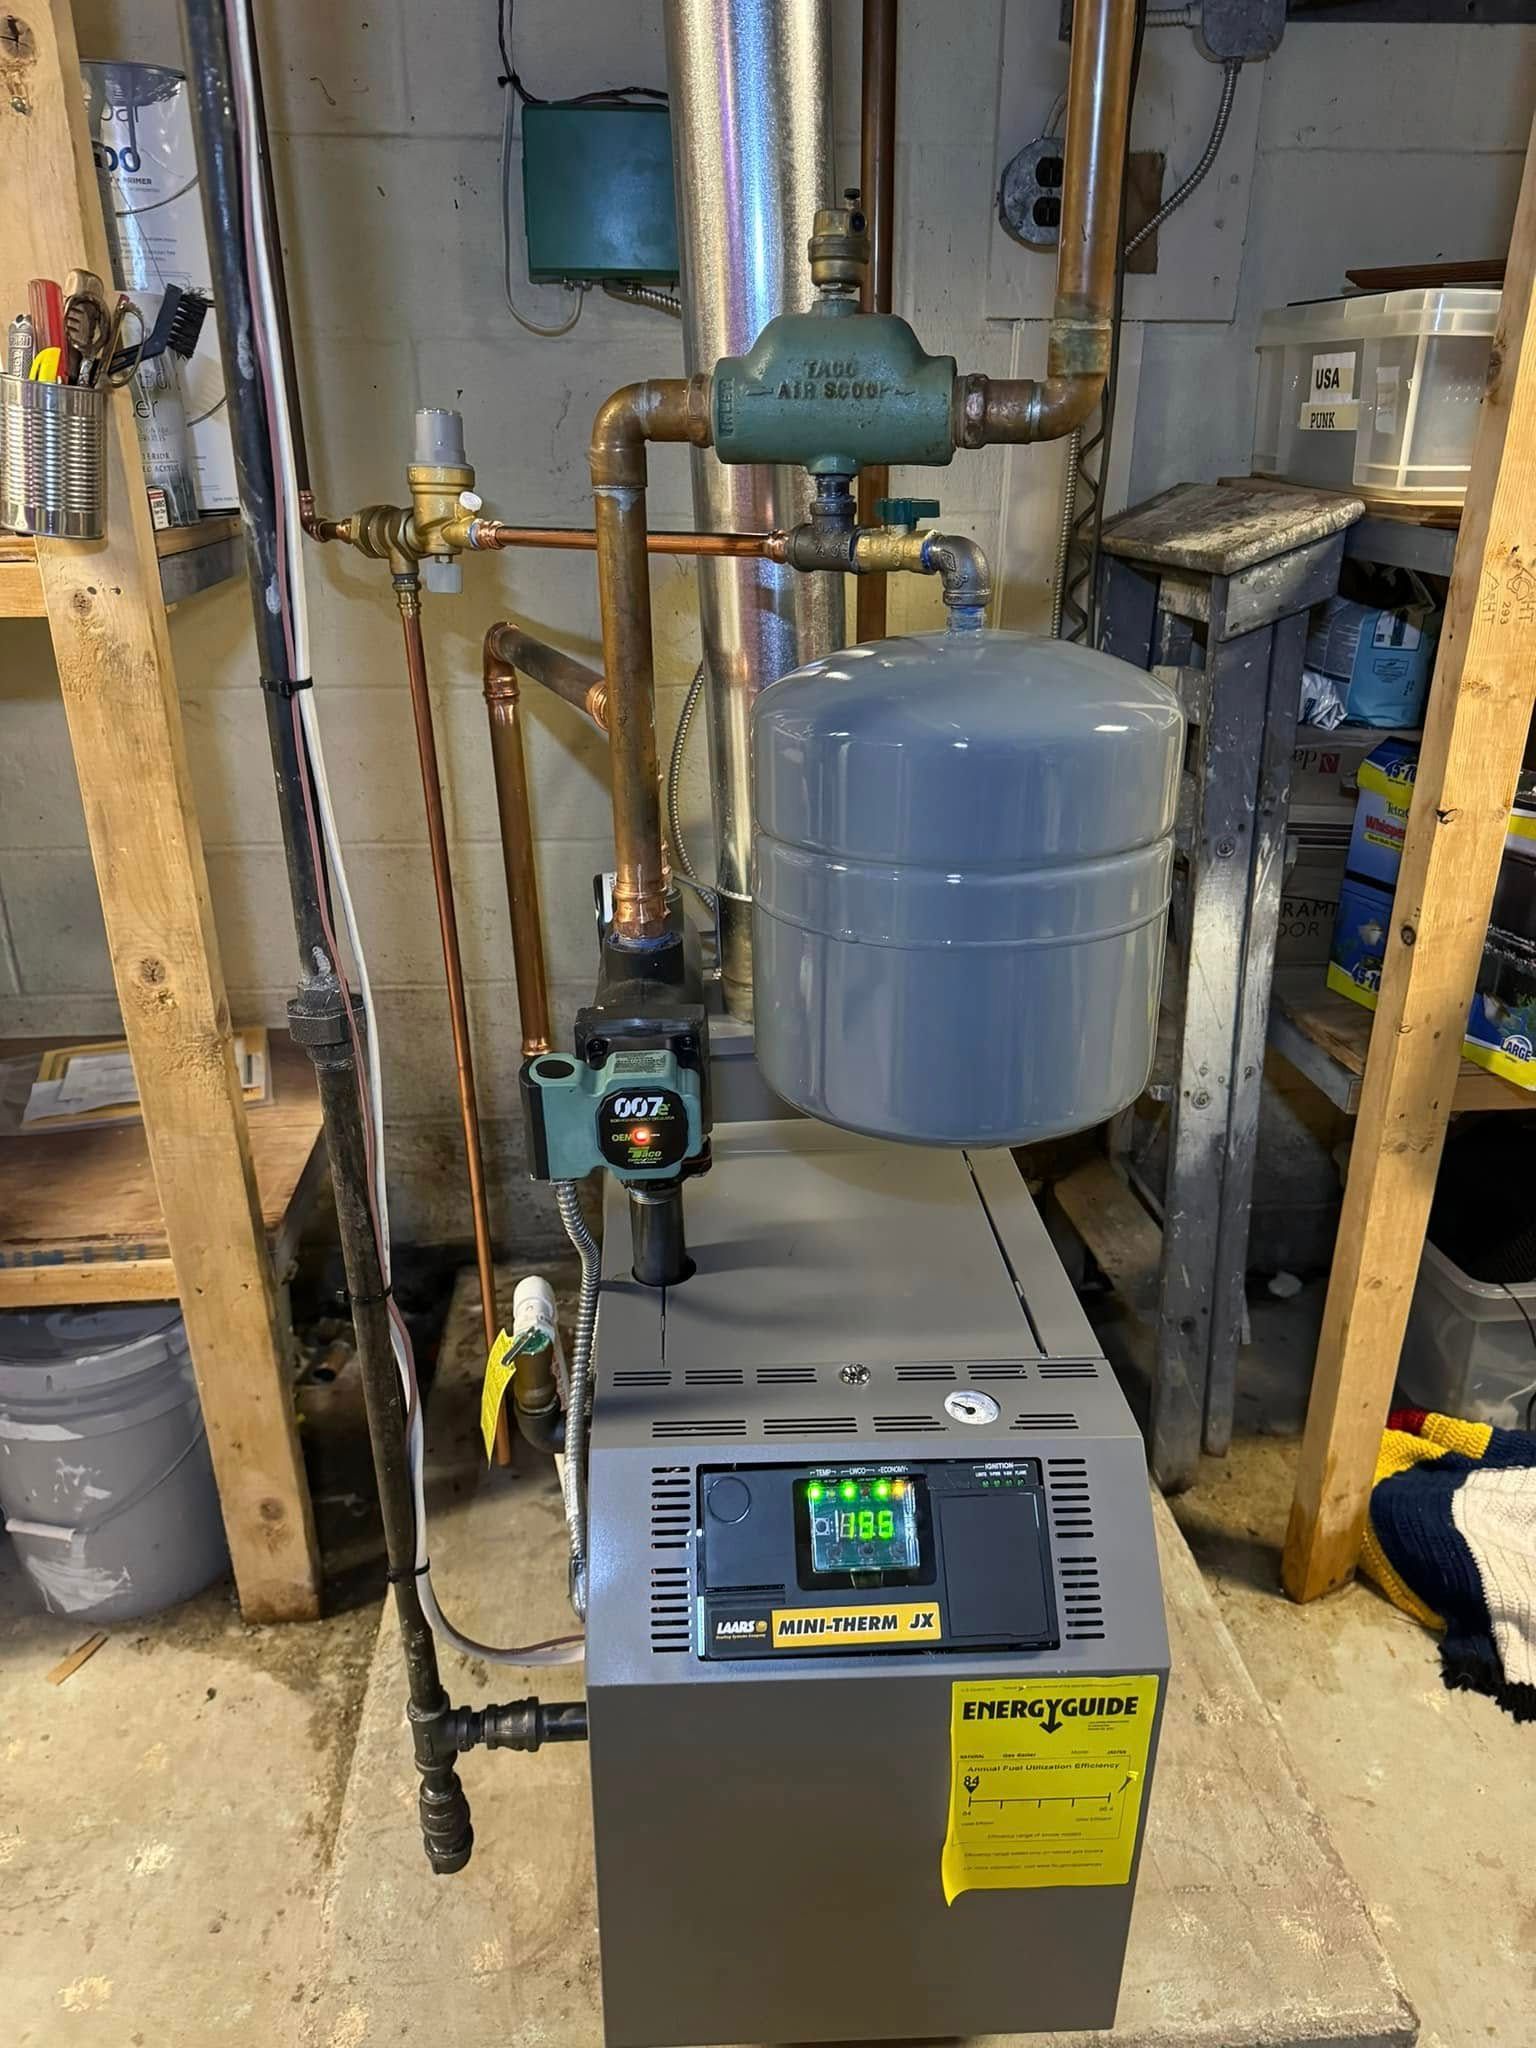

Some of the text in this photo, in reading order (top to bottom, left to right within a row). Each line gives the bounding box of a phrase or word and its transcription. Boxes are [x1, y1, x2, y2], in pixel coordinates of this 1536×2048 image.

[1315, 367, 1340, 390] USA
[777, 381, 816, 399] AIR
[1310, 412, 1335, 429] PUNK
[1500, 600, 1511, 625] 293
[1500, 1040, 1532, 1063] LARGE
[881, 1465, 906, 1474] ECONOMY
[984, 1462, 1014, 1470] IGNITION
[716, 1619, 755, 1635] LAARS
[778, 1612, 934, 1636] MINI-THERM JX
[962, 1696, 1139, 1723] ENERGYGUIDE
[967, 1761, 1120, 1773] Annual Fuel Utilization Efficiency
[963, 1775, 980, 1787] 84
